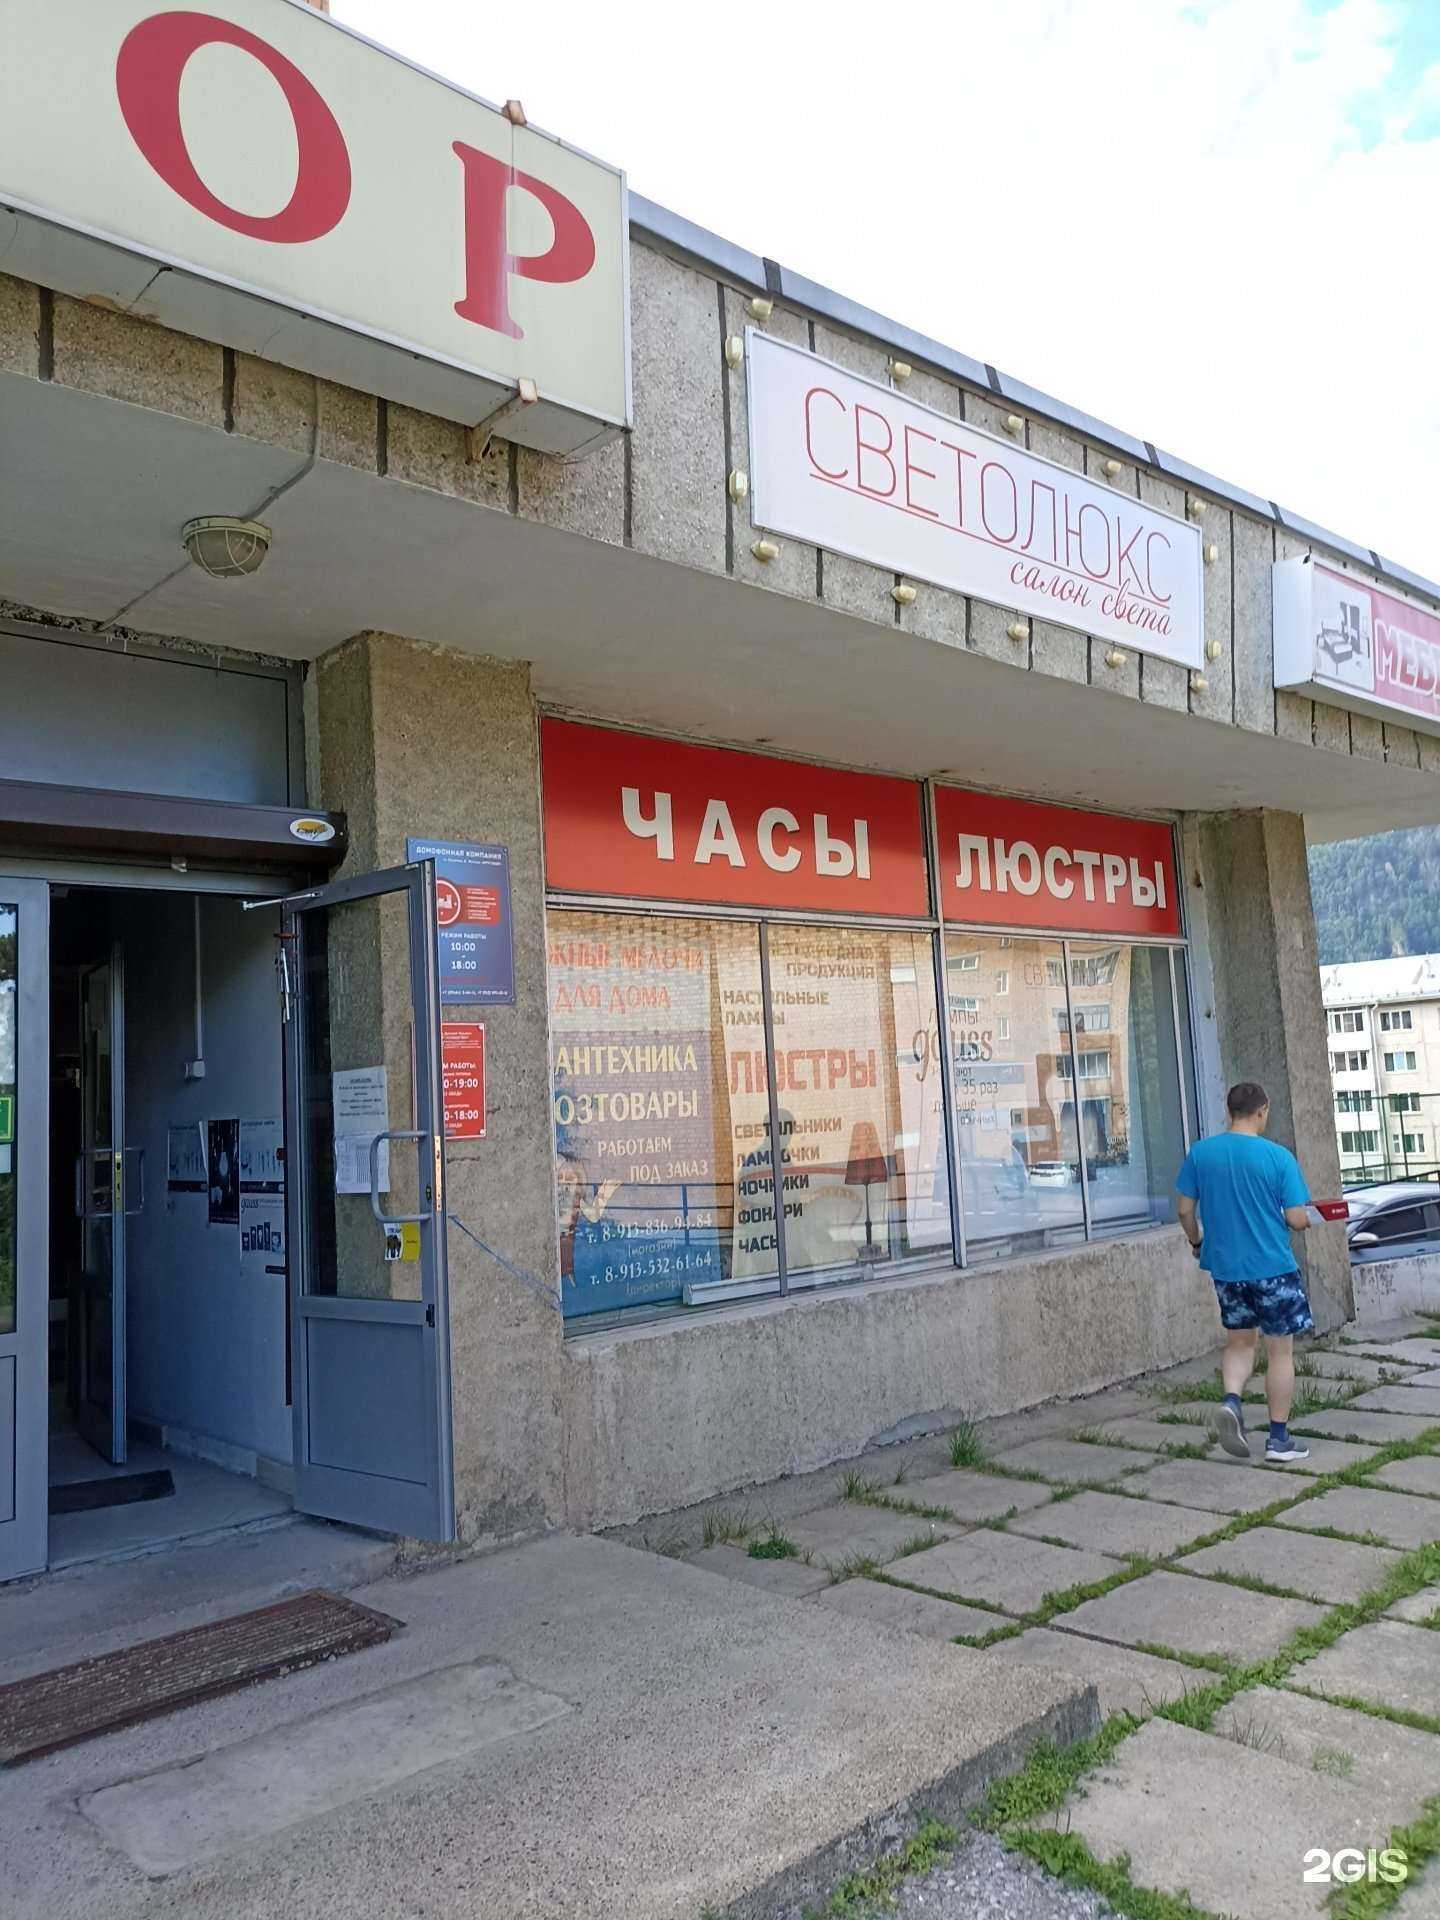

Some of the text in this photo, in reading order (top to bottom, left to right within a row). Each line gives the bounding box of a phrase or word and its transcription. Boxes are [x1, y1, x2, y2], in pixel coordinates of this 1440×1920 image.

[804, 387, 1172, 602] СВЕТОЛЮКС
[1010, 561, 1172, 635] салон света
[1374, 618, 1440, 700] МЕБ
[621, 786, 871, 880] ЧАСЫ
[955, 833, 1167, 909] ЛЮСТРЫ
[451, 942, 476, 951] 10:00
[451, 961, 477, 970] 18:00
[786, 961, 875, 980] ПРОДУКЦИЯ
[555, 981, 671, 1015] ДЛЯ ДОМА
[723, 989, 830, 1006] НАСТЛЬНЫЕ
[725, 1010, 785, 1026] ЛАМЫ
[929, 1008, 978, 1026] ЛМПЫ
[555, 1044, 698, 1076] АНТЕХНИКА
[961, 1079, 999, 1096] 35 раз
[555, 1088, 698, 1125] ОЗТОВАРЫ
[598, 1136, 672, 1157] РАБОТАЕМ
[630, 1159, 708, 1183] ПОД ЗАКАЗ
